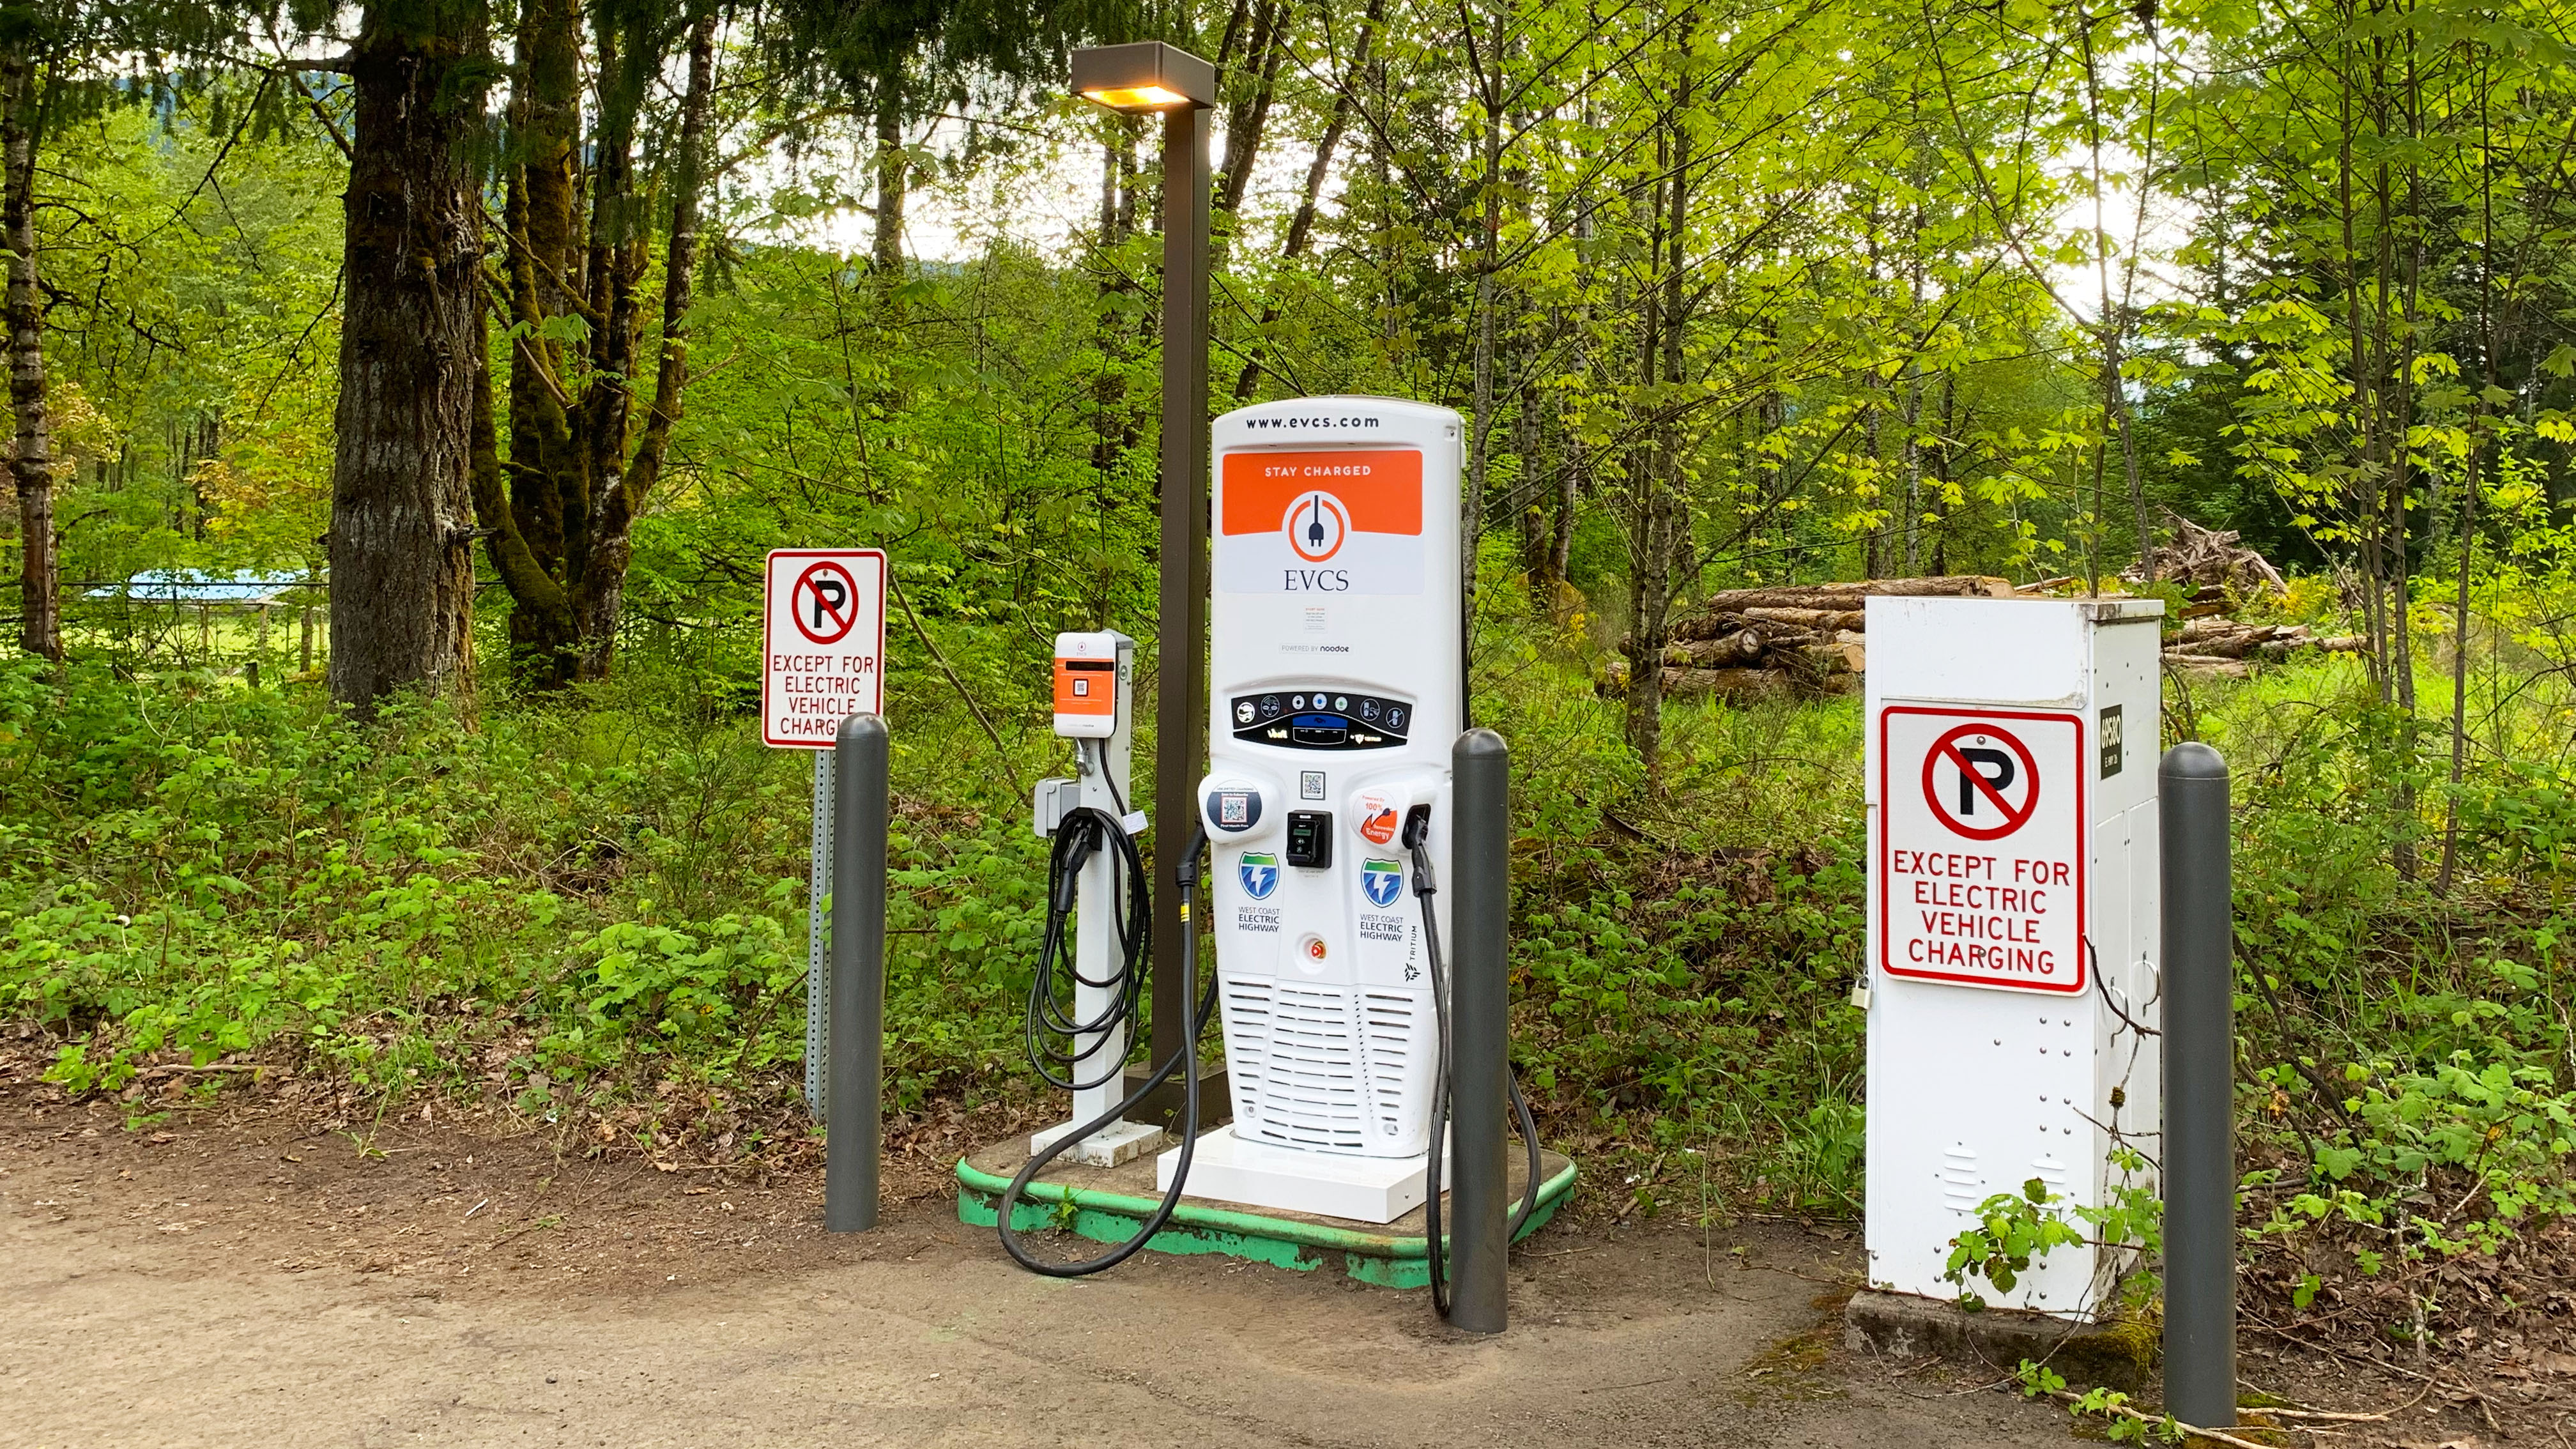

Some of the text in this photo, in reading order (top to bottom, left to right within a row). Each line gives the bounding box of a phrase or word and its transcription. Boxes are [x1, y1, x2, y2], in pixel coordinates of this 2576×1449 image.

[1246, 416, 1379, 429] www.evcs.com
[1265, 466, 1371, 477] STAY CHARGED
[1284, 569, 1349, 592] EVCS
[774, 655, 873, 673] EXCEPT FOR
[785, 676, 861, 694] ELECTRIC
[789, 697, 856, 715] VEHICLE
[2101, 714, 2122, 749] 69580
[1365, 802, 1383, 811] 100%
[1366, 827, 1390, 841] Energy
[1894, 850, 2070, 886] EXCEPT FOR
[1915, 881, 2047, 914] ELECTRIC
[1239, 914, 1280, 924] ELECTRIC
[1360, 914, 1404, 924] WEST COAST
[1921, 910, 2040, 944] VEHICLE
[1239, 923, 1279, 933] HIGHWAY
[1360, 922, 1404, 933] ELECTRIC
[1360, 931, 1403, 942] HIGHWAY
[1909, 939, 2055, 975] CHARGING
